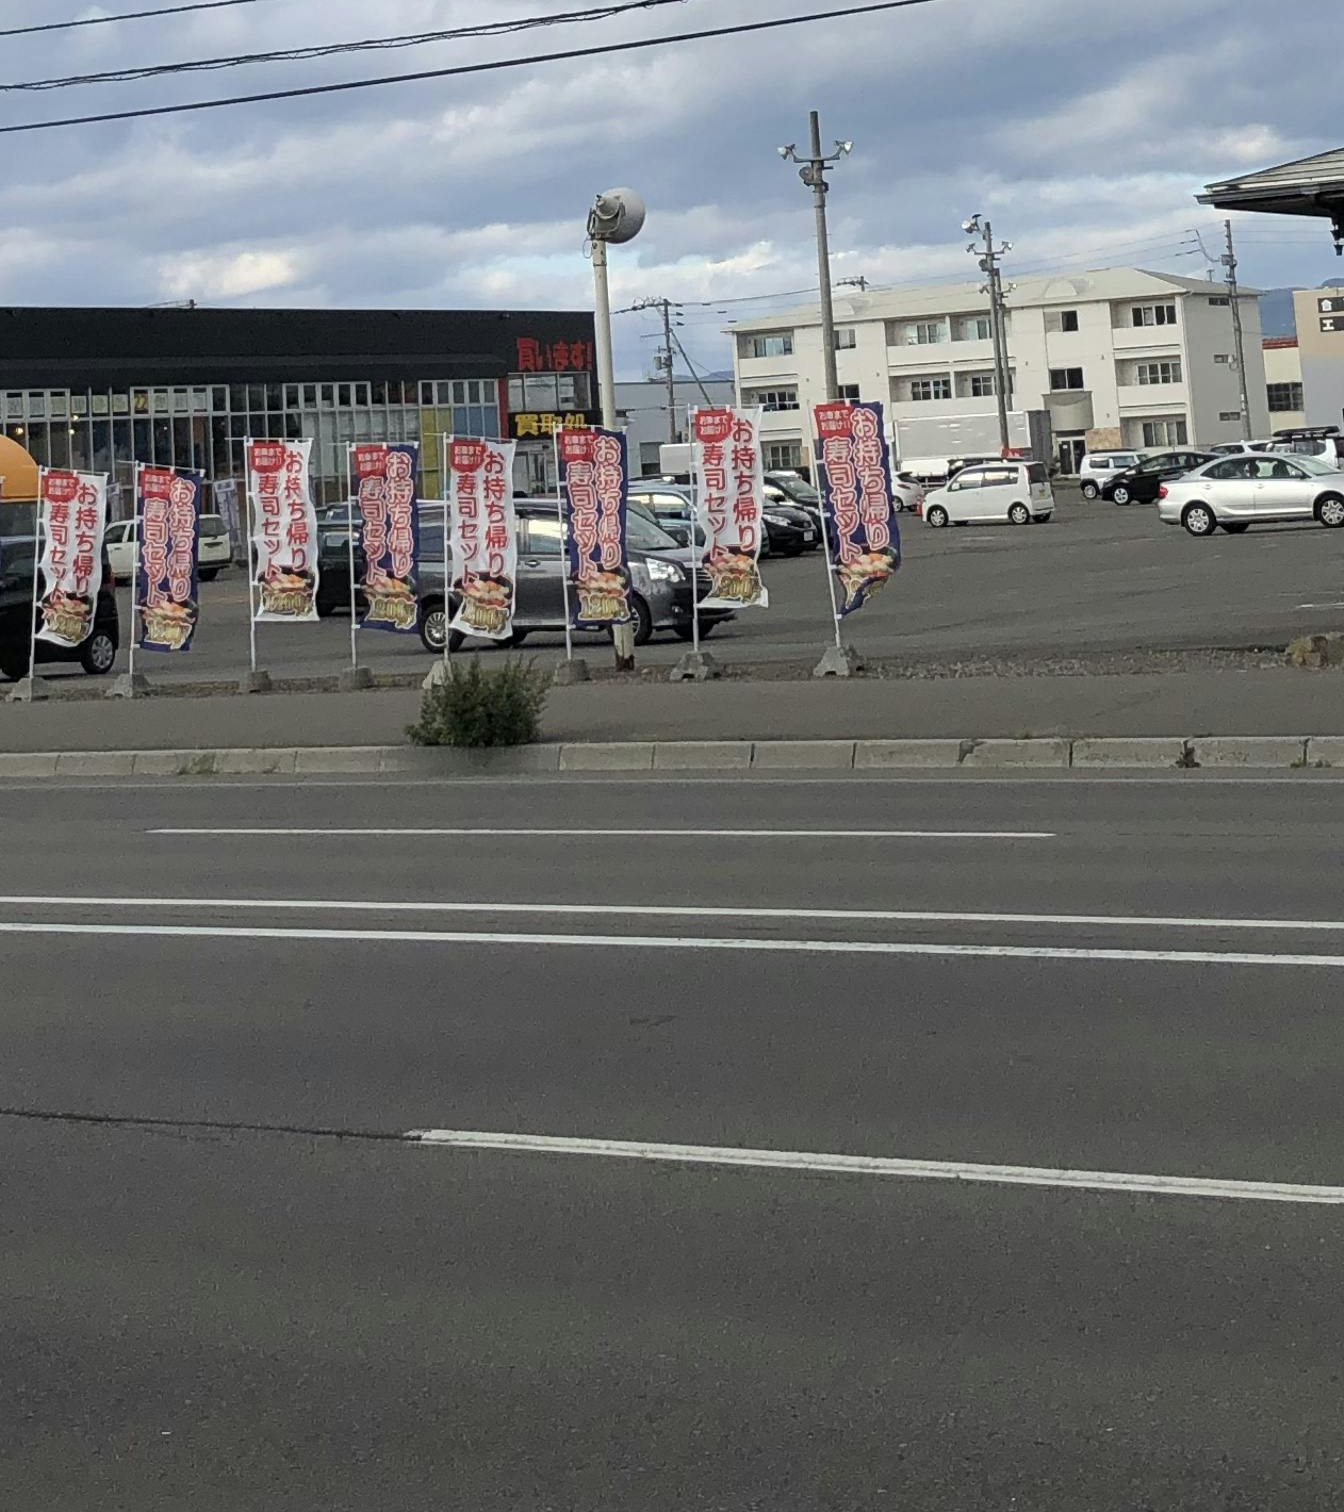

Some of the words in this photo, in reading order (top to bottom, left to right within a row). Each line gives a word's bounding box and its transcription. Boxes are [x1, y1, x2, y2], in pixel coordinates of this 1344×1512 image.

[72, 482, 99, 598] お持ち帰り
[258, 473, 283, 584] 寿司セット
[284, 450, 309, 572] お持ち帰り
[359, 476, 387, 585] 寿司セット
[456, 471, 479, 585] 寿司セット
[482, 450, 509, 577] お持ち帰り
[567, 460, 598, 581] 寿司セット
[593, 435, 623, 570] お持ち帰り
[701, 440, 729, 562] 寿司セット
[730, 418, 758, 552] お持ち帰り
[823, 436, 863, 565] 寿司セット
[850, 407, 891, 551] お持ち帰り
[142, 497, 168, 607] 寿司セット
